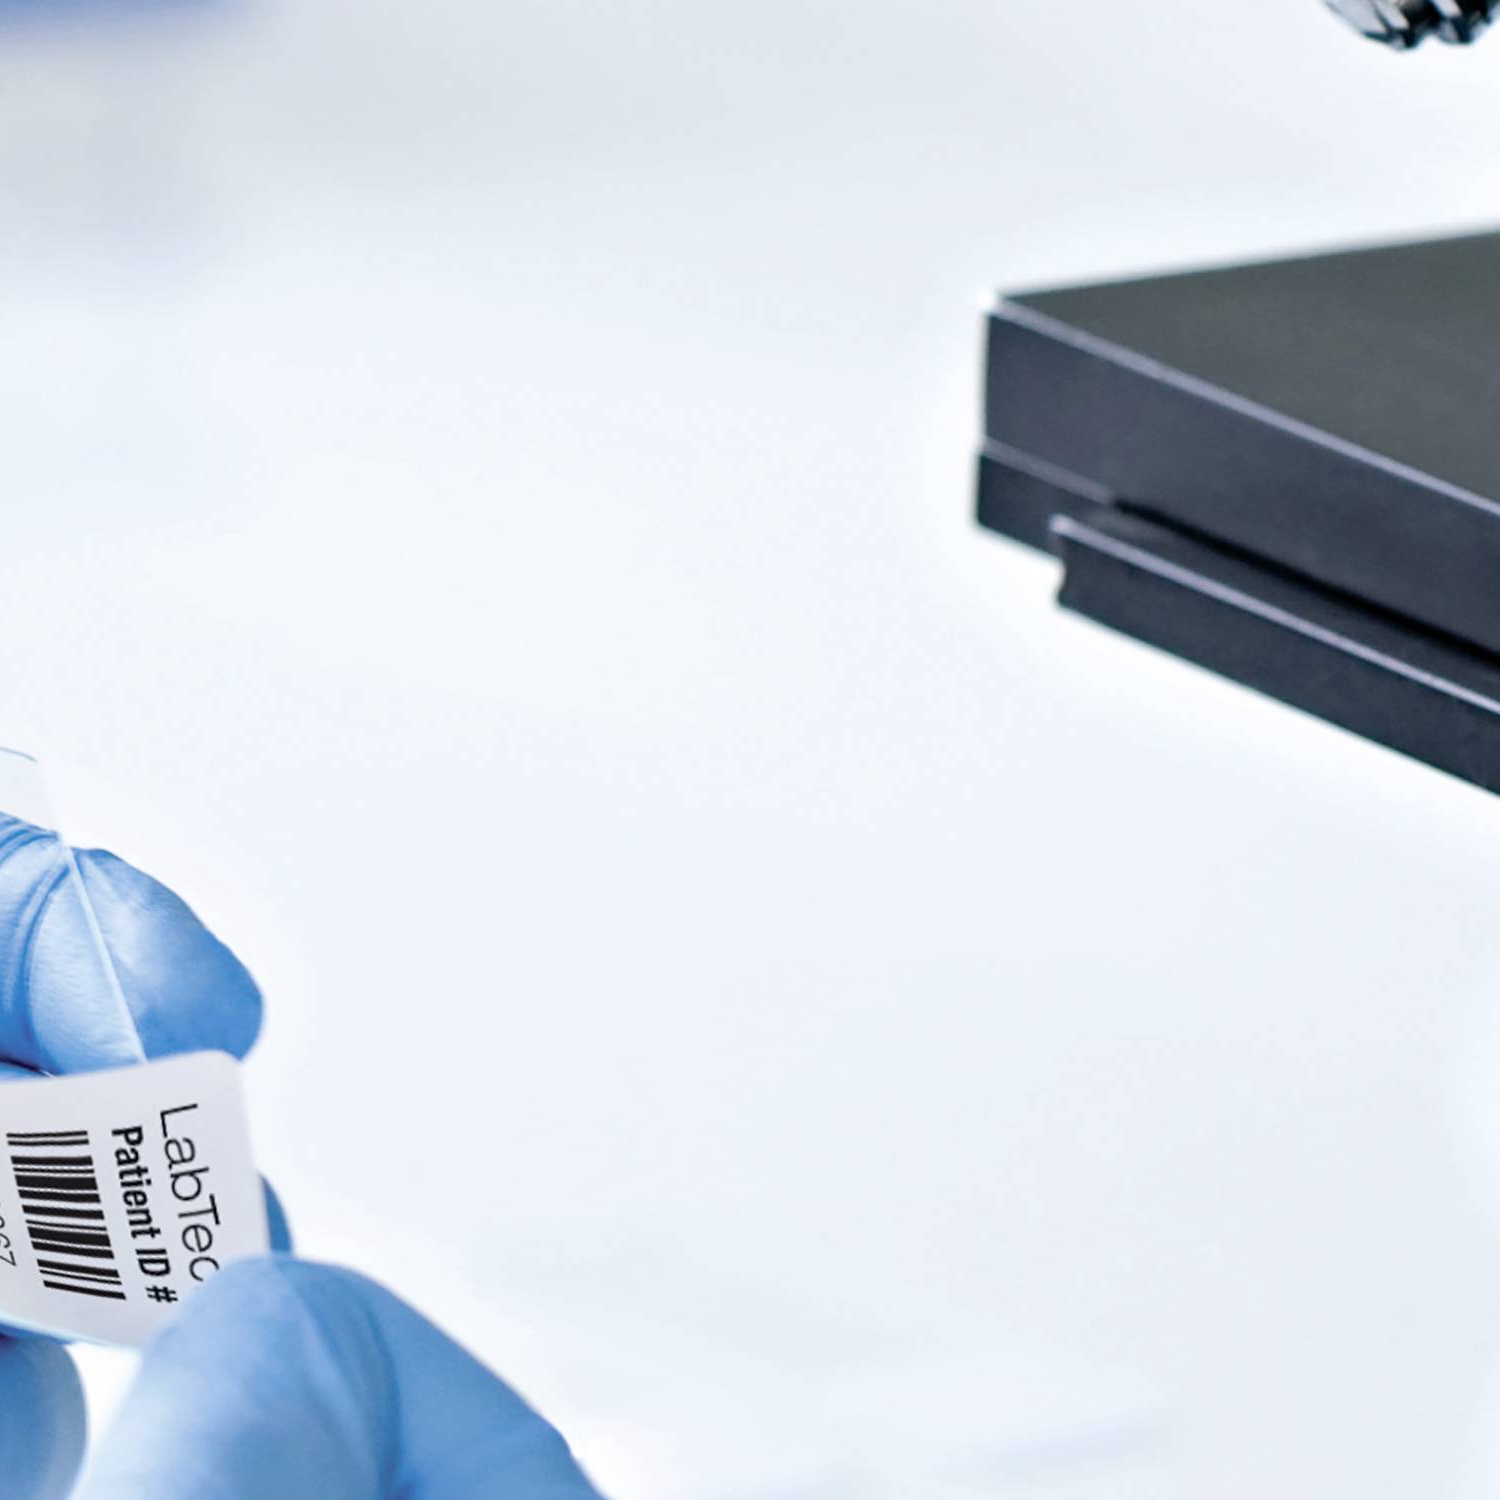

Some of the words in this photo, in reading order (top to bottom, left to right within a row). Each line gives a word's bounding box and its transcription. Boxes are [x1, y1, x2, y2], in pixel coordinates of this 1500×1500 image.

[111, 1125, 162, 1239] Patient
[160, 1103, 221, 1282] LabTec
[135, 1247, 171, 1277] ID
[145, 1284, 179, 1303] #
